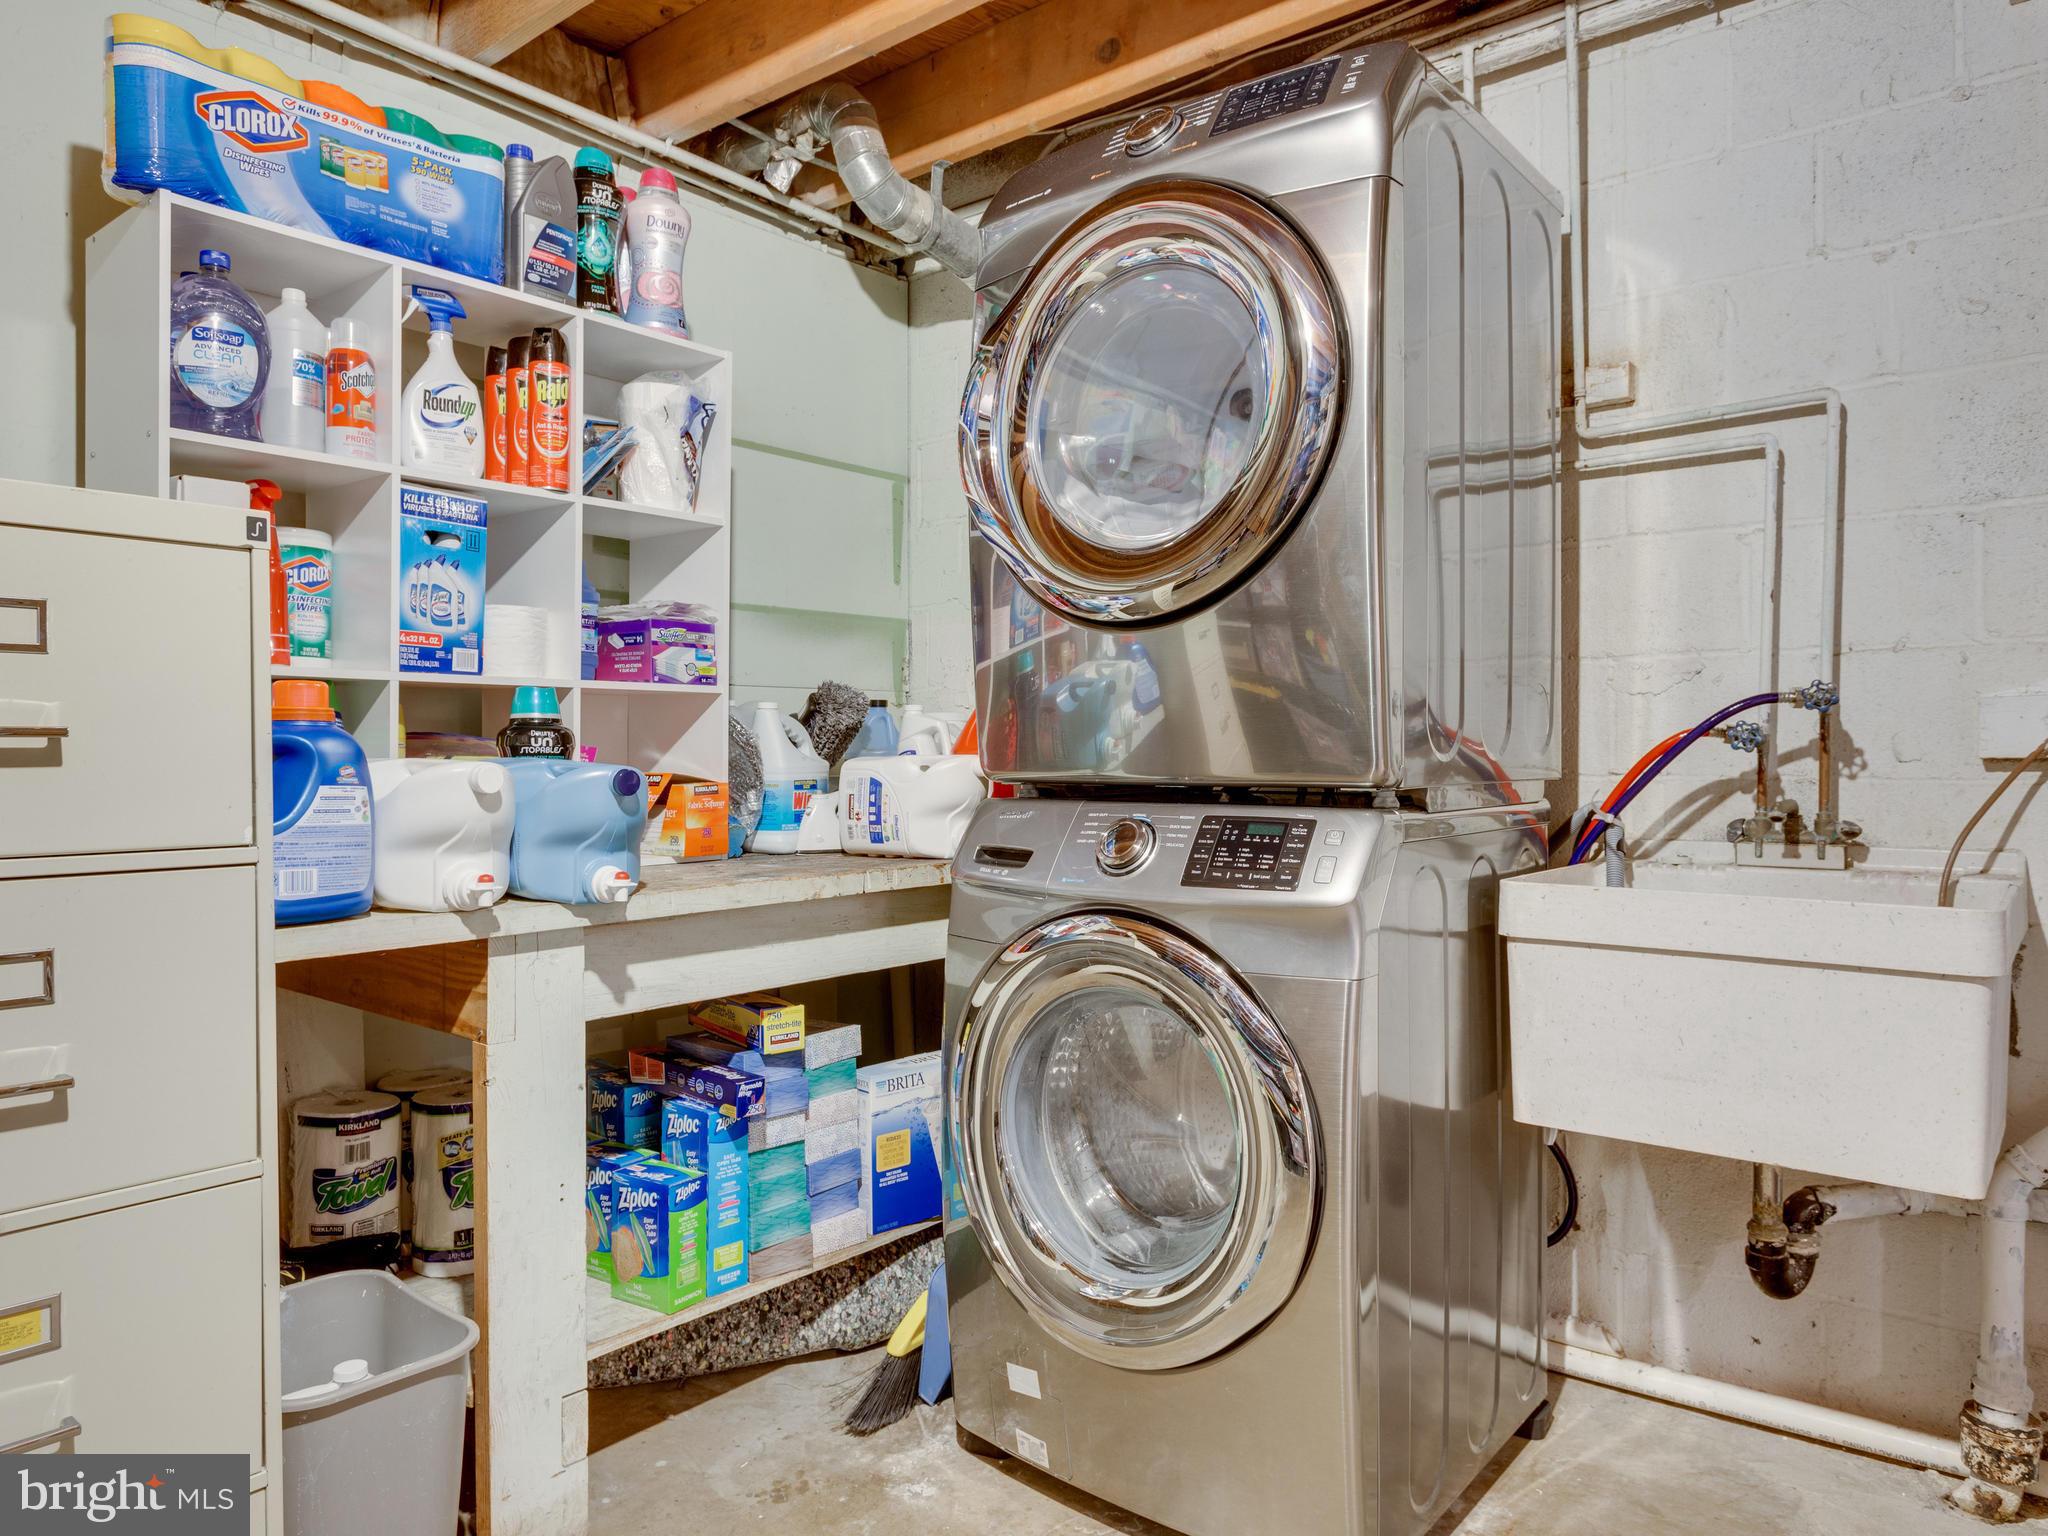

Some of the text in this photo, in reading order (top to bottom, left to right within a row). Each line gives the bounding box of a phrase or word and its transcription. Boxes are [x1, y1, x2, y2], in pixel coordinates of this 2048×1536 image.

[208, 103, 298, 138] CLOROX
[298, 104, 320, 118] Kills
[322, 111, 363, 131] 99.9%
[363, 127, 374, 137] of
[415, 143, 422, 151] &
[423, 146, 461, 163] Bacteria
[223, 148, 285, 173] DISINFECTING
[240, 162, 270, 178] WIPES
[429, 169, 454, 185] WIPES
[582, 196, 620, 209] STOPABLES
[647, 215, 685, 239] Downy
[194, 327, 243, 345] Softsoap
[194, 343, 241, 354] ADVNCED
[295, 361, 315, 373] 70%
[537, 379, 568, 401] Raid
[423, 389, 477, 421] Roundup
[403, 493, 434, 507] KILLS
[465, 504, 479, 514] OF
[403, 503, 436, 514] VIRUSES
[442, 509, 479, 522] BACTERIA
[286, 566, 331, 585] CLOROX
[296, 603, 322, 612] WIPES
[531, 730, 556, 738] Downy
[766, 1020, 802, 1031] stretch-tite
[767, 1011, 782, 1021] 750
[740, 1081, 763, 1091] Reynolds
[887, 1072, 925, 1093] BRITA
[592, 1089, 617, 1112] Ziploc
[338, 1119, 380, 1132] KIRKLAND
[667, 1113, 700, 1138] Ziploc
[355, 1158, 387, 1176] Premium
[317, 1158, 395, 1214] Towel
[675, 1180, 701, 1203] Ziploc
[618, 1186, 658, 1212] Ziploc
[643, 1217, 654, 1225] Easy
